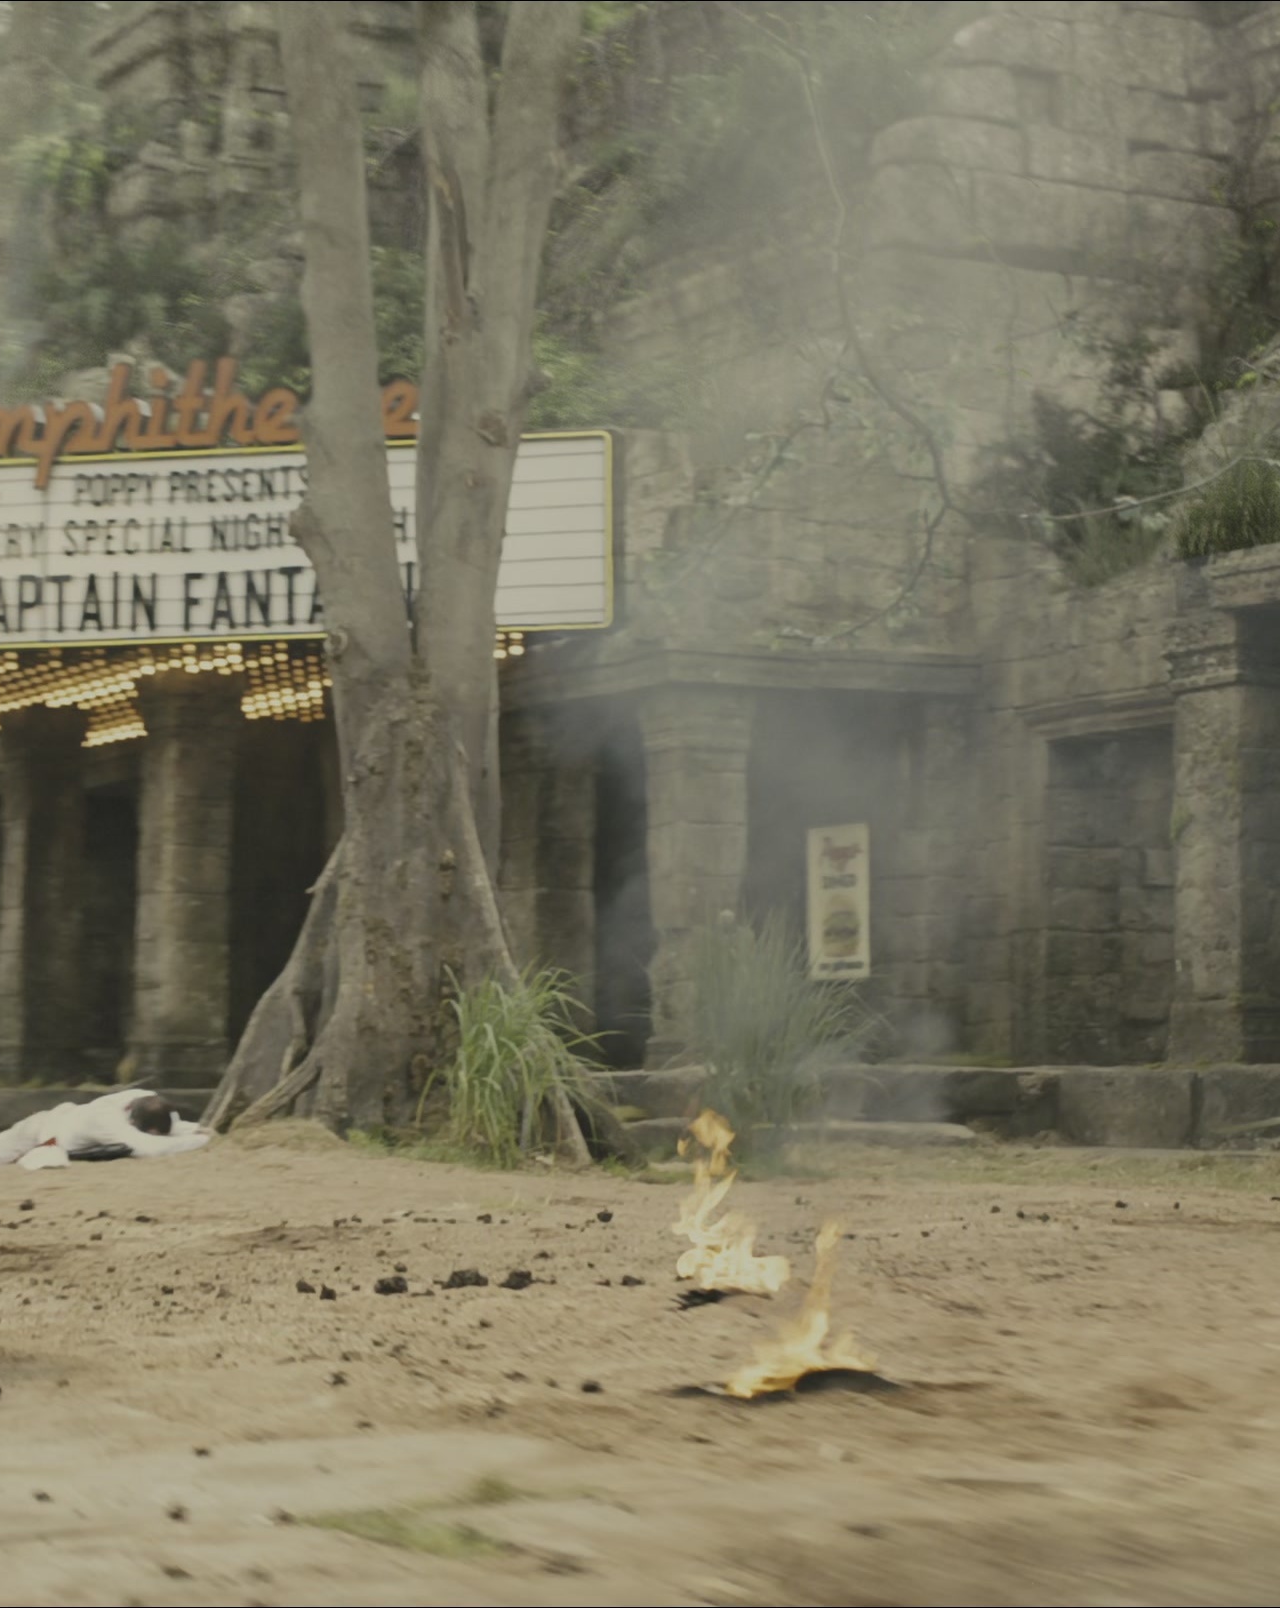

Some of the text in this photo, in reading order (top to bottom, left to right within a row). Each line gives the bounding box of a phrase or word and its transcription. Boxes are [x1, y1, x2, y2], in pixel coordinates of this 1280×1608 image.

[72, 472, 153, 507] POPPY
[63, 516, 193, 557] SPECIAL
[210, 511, 286, 551] NIGH
